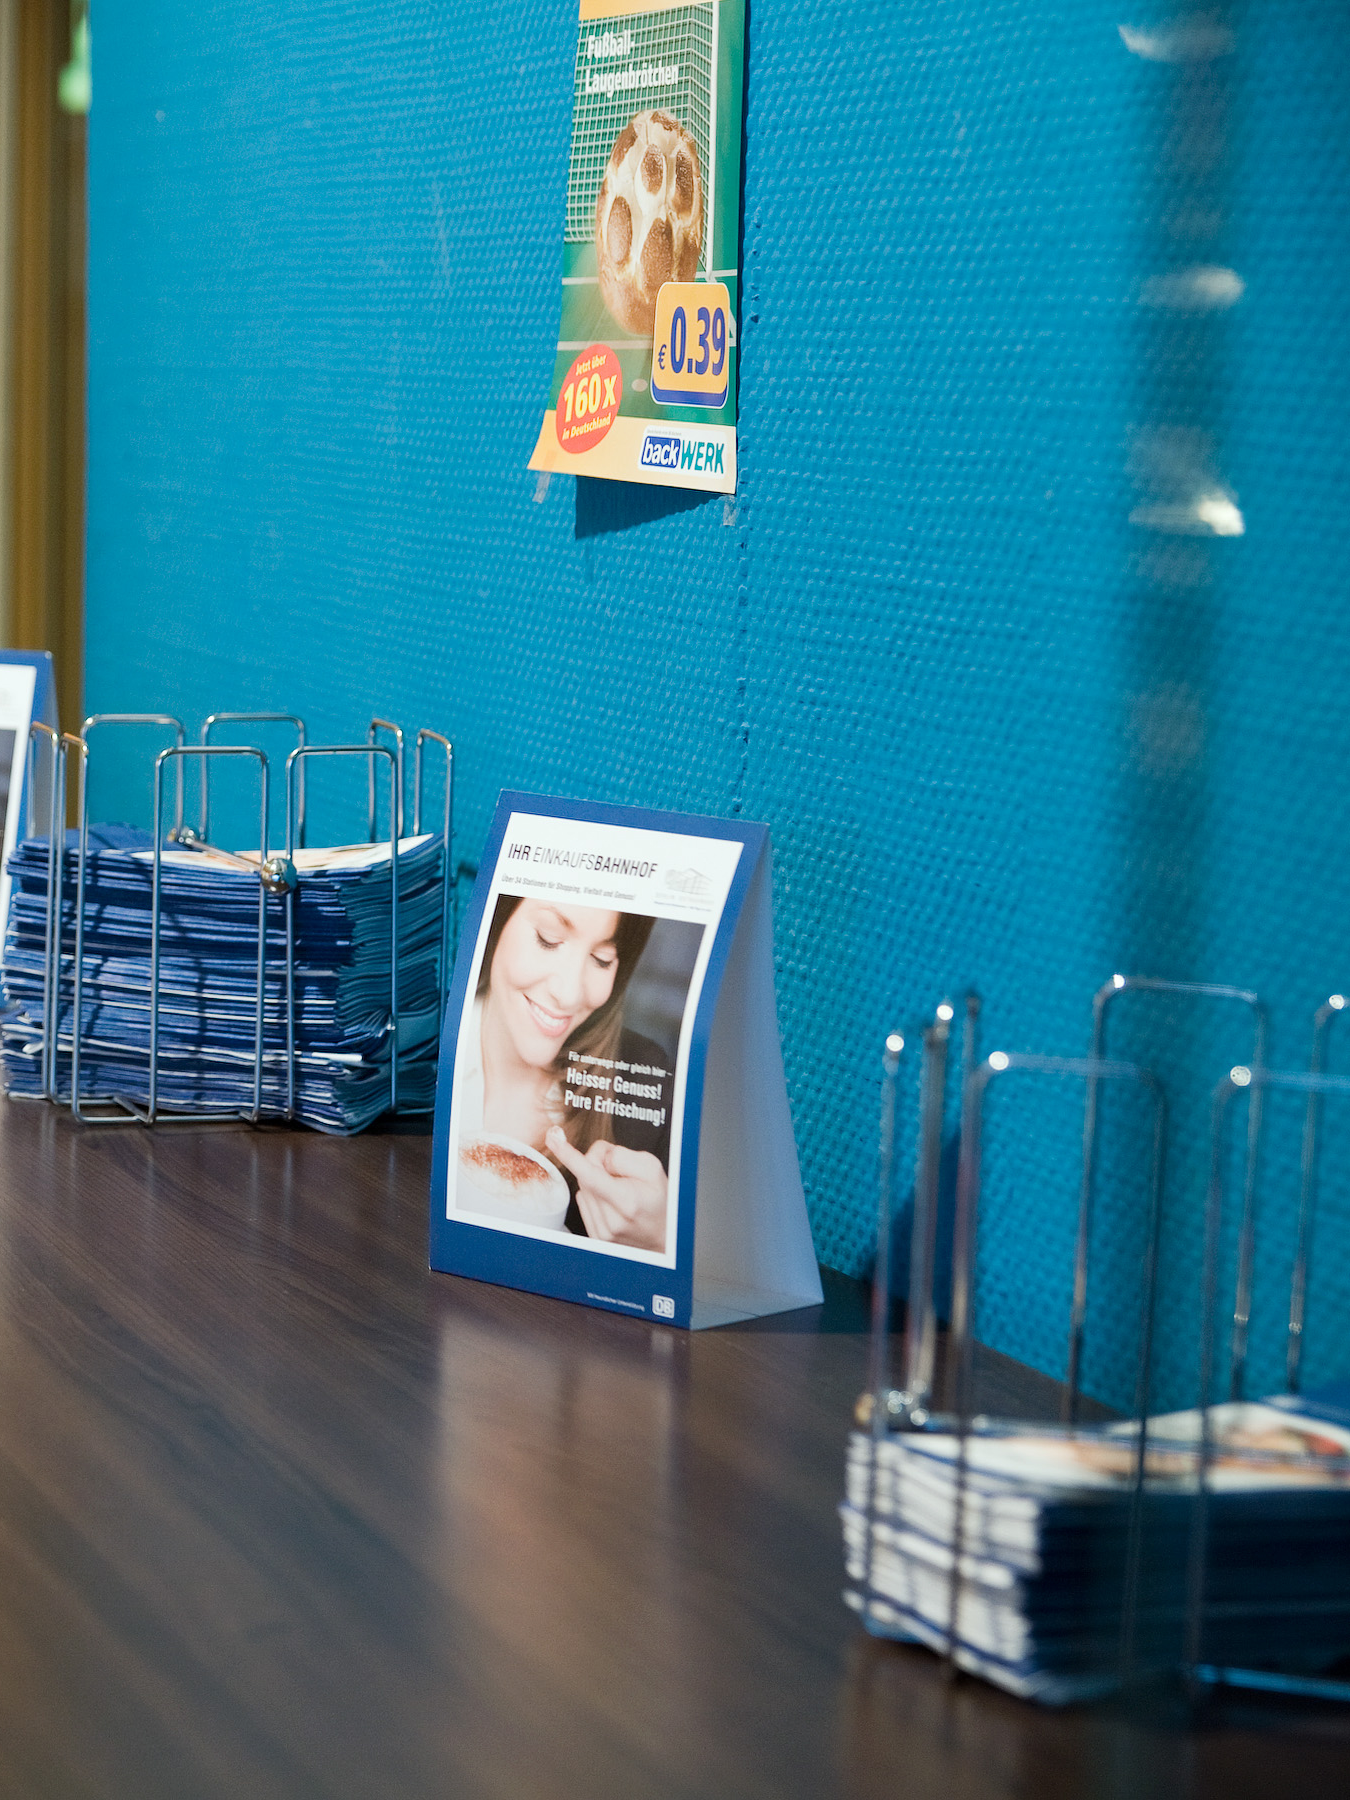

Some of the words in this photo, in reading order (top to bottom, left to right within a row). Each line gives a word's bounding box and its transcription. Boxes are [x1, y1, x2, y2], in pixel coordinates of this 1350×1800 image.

[587, 29, 635, 59] Fußball-
[585, 60, 679, 97] Laugenbrötchen
[658, 344, 667, 370] €
[670, 306, 726, 376] 0.39
[575, 360, 591, 376] Jetzt
[592, 354, 607, 369] über
[564, 373, 602, 423] 160
[562, 428, 570, 441] in
[570, 413, 611, 438] Deutschland
[508, 843, 531, 861] IHR
[532, 846, 658, 878] EINKAUFSBAHNHOF
[566, 1067, 612, 1091] Heisser
[613, 1076, 662, 1100] Genuss!
[564, 1090, 591, 1110] Pure
[594, 1095, 666, 1127] Erfrischung!
[654, 1296, 673, 1316] DB
